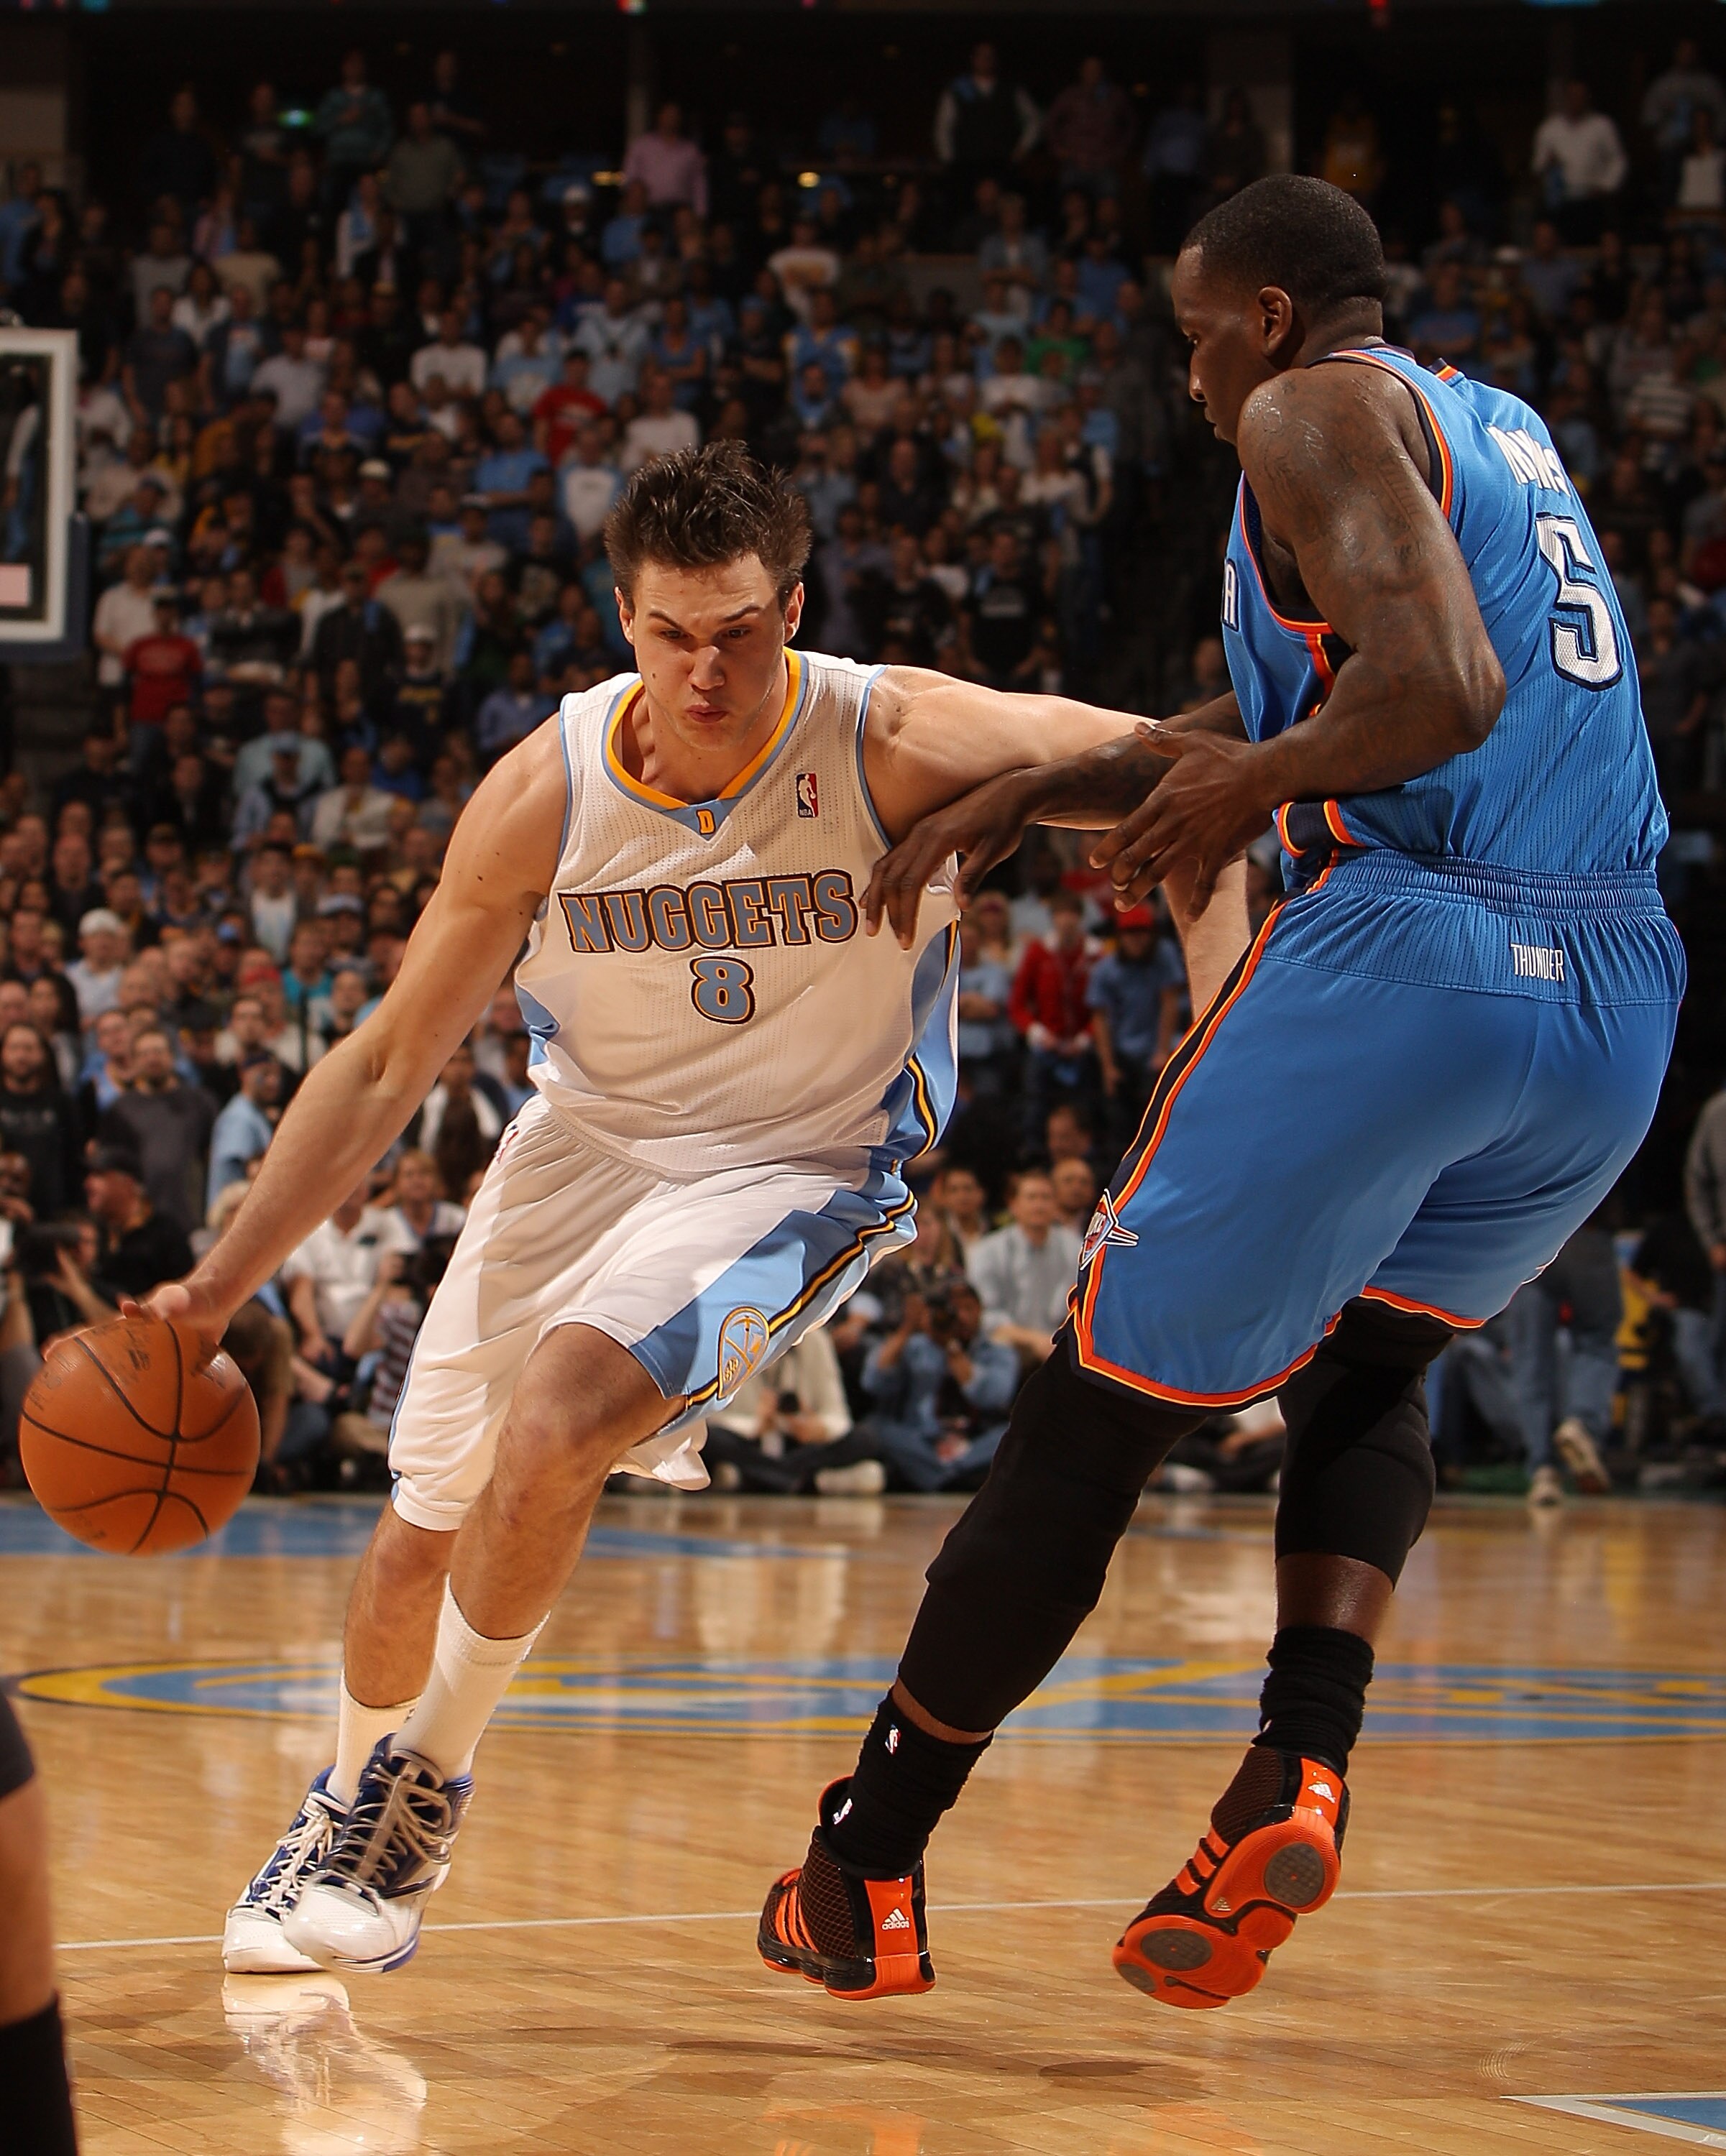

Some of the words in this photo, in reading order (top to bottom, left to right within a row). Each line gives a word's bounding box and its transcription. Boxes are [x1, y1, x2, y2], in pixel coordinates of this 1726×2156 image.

[1536, 512, 1623, 692] 5
[696, 808, 716, 834] D
[557, 868, 859, 954] NUGGETS
[1510, 943, 1565, 982] THUNDER
[689, 955, 756, 1026] 8
[881, 1920, 910, 1930] adidas
